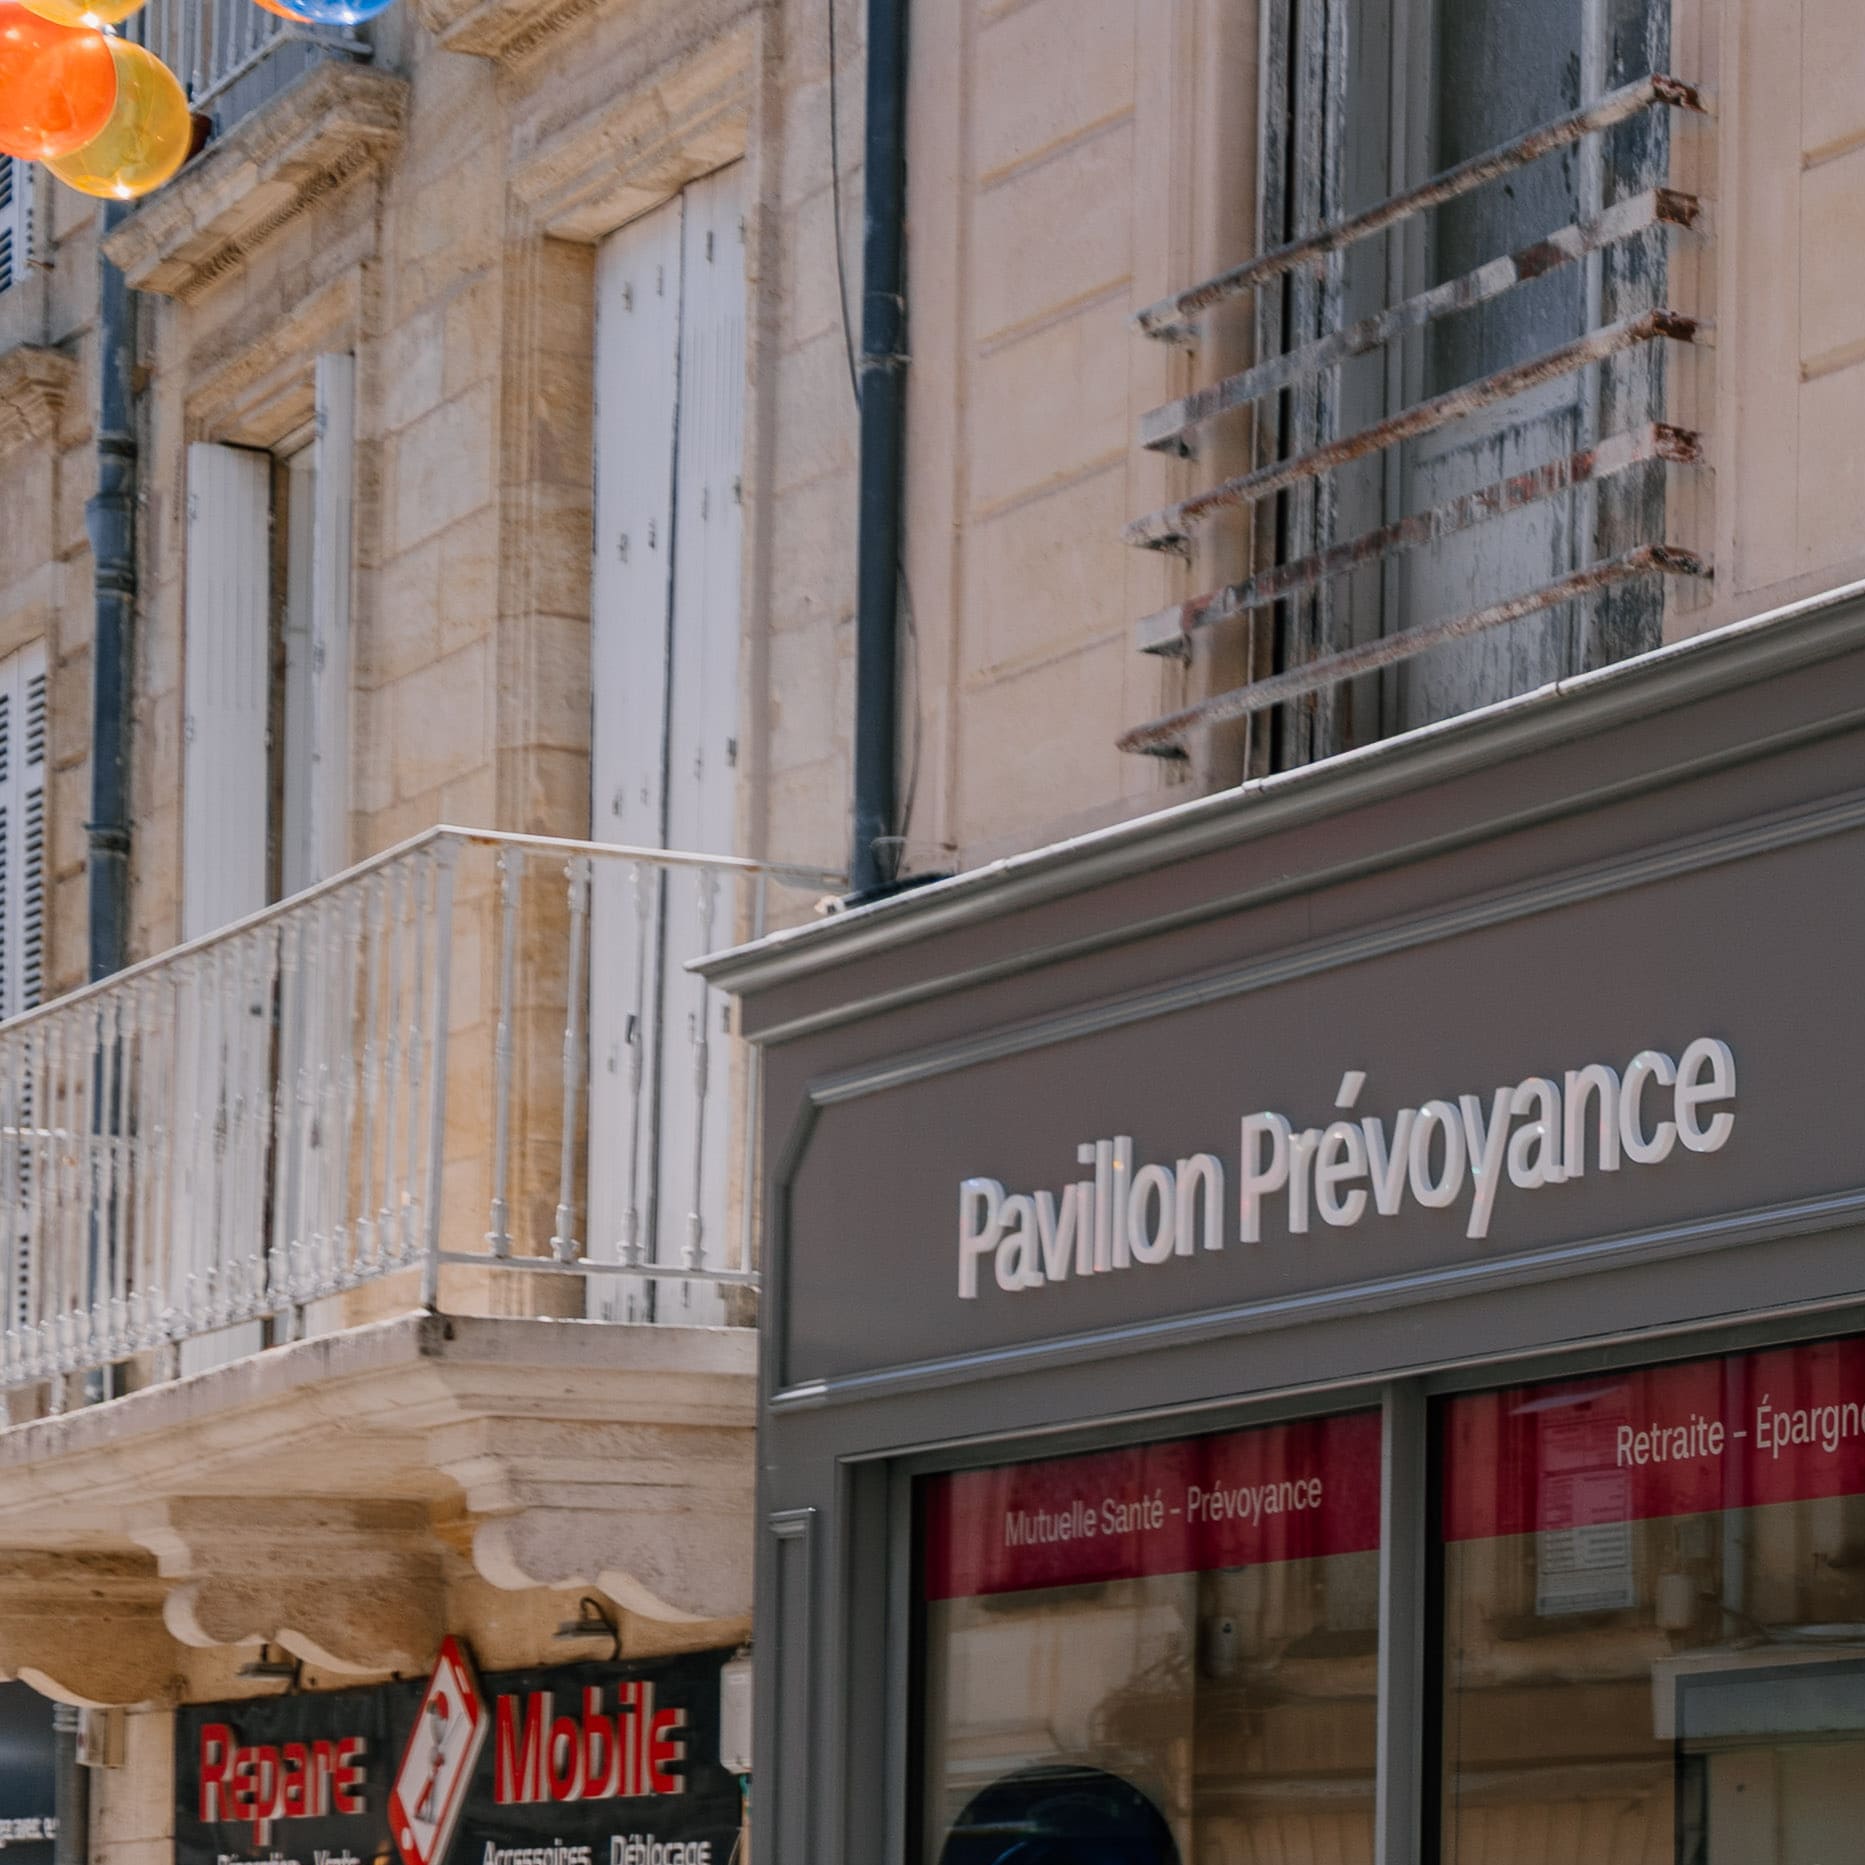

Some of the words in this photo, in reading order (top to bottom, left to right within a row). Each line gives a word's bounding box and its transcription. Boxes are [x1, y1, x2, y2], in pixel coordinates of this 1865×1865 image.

[957, 1135, 1225, 1299] Pavillon
[1240, 1036, 1736, 1240] Prévoyance
[1616, 1413, 1725, 1467] Retraite
[1005, 1500, 1097, 1547] Mutuelle
[1100, 1488, 1164, 1536] Santé
[1187, 1477, 1323, 1528] Prévoyance
[494, 1681, 688, 1805] Mobile
